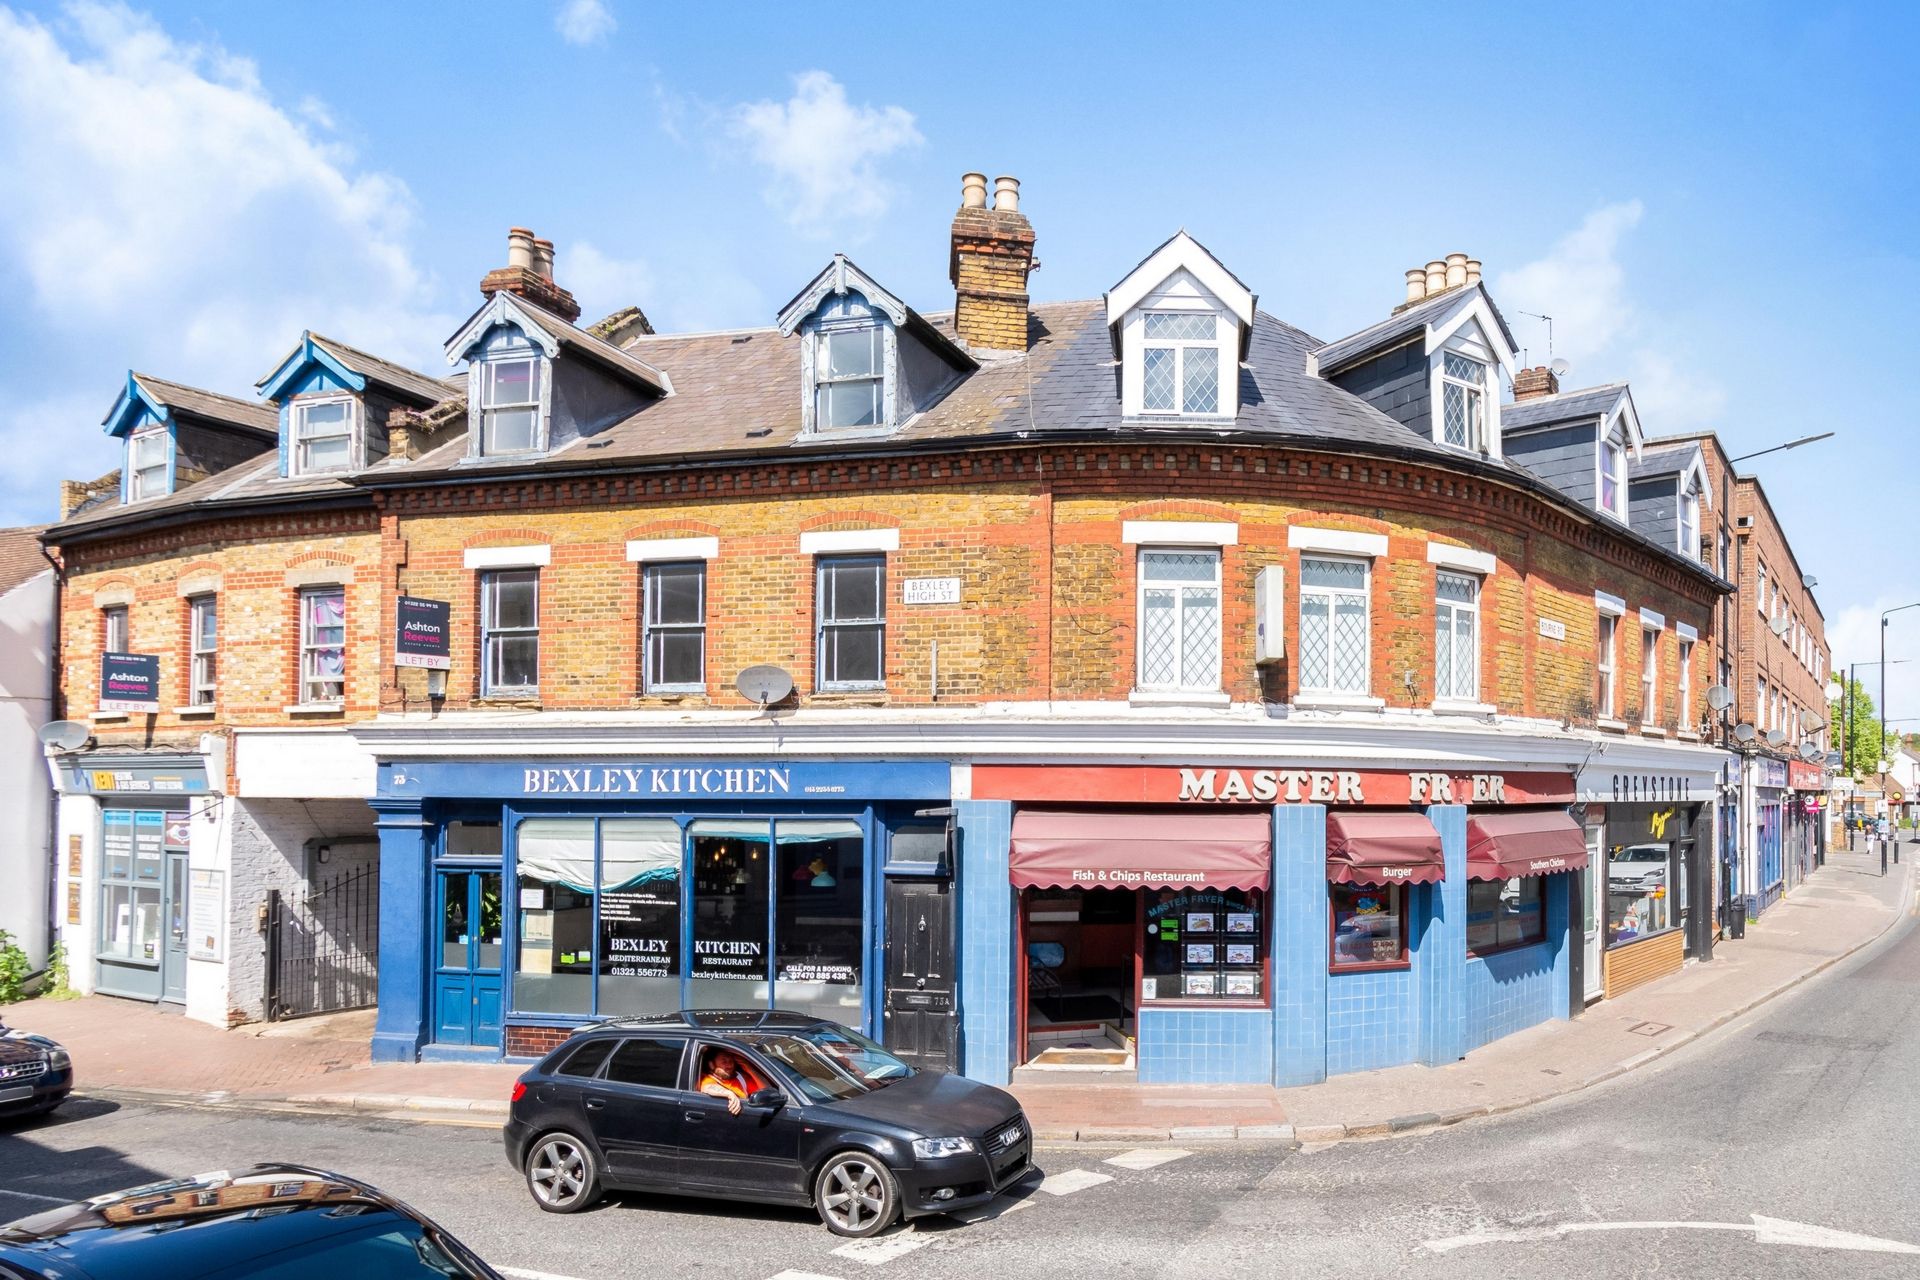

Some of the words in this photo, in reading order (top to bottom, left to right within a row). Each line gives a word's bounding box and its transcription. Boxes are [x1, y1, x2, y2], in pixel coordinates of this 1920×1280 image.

[912, 581, 952, 591] BEXLEY
[907, 591, 936, 601] HIGH
[941, 591, 953, 600] ST
[404, 621, 441, 633] Ashton
[404, 631, 441, 643] Reeves
[405, 656, 424, 665] LET
[427, 658, 440, 666] BY
[109, 673, 149, 682] Ashton
[110, 702, 129, 710] LET
[133, 703, 147, 711] BY
[523, 768, 643, 793] BEXLEY
[650, 768, 790, 793] KITCHEN
[1178, 768, 1365, 803] MASTER
[1613, 774, 1690, 802] GREYSTONE
[1072, 870, 1095, 881] Fish
[1097, 870, 1107, 881] &
[1109, 870, 1141, 883] Chips
[1143, 871, 1206, 882] Restaurant
[1382, 867, 1413, 879] Burger
[1147, 896, 1188, 918] MASTER
[1191, 895, 1225, 905] FRYER
[611, 938, 669, 952] BEXLEY
[694, 941, 761, 955] KITCHEN
[608, 954, 671, 964] MEDITERRANEAN
[702, 957, 753, 966] RESTAURANT
[611, 967, 636, 976] 01322
[637, 968, 668, 978] 556773
[822, 965, 852, 973] BOOKING
[691, 970, 764, 981] bexleykitchens.com
